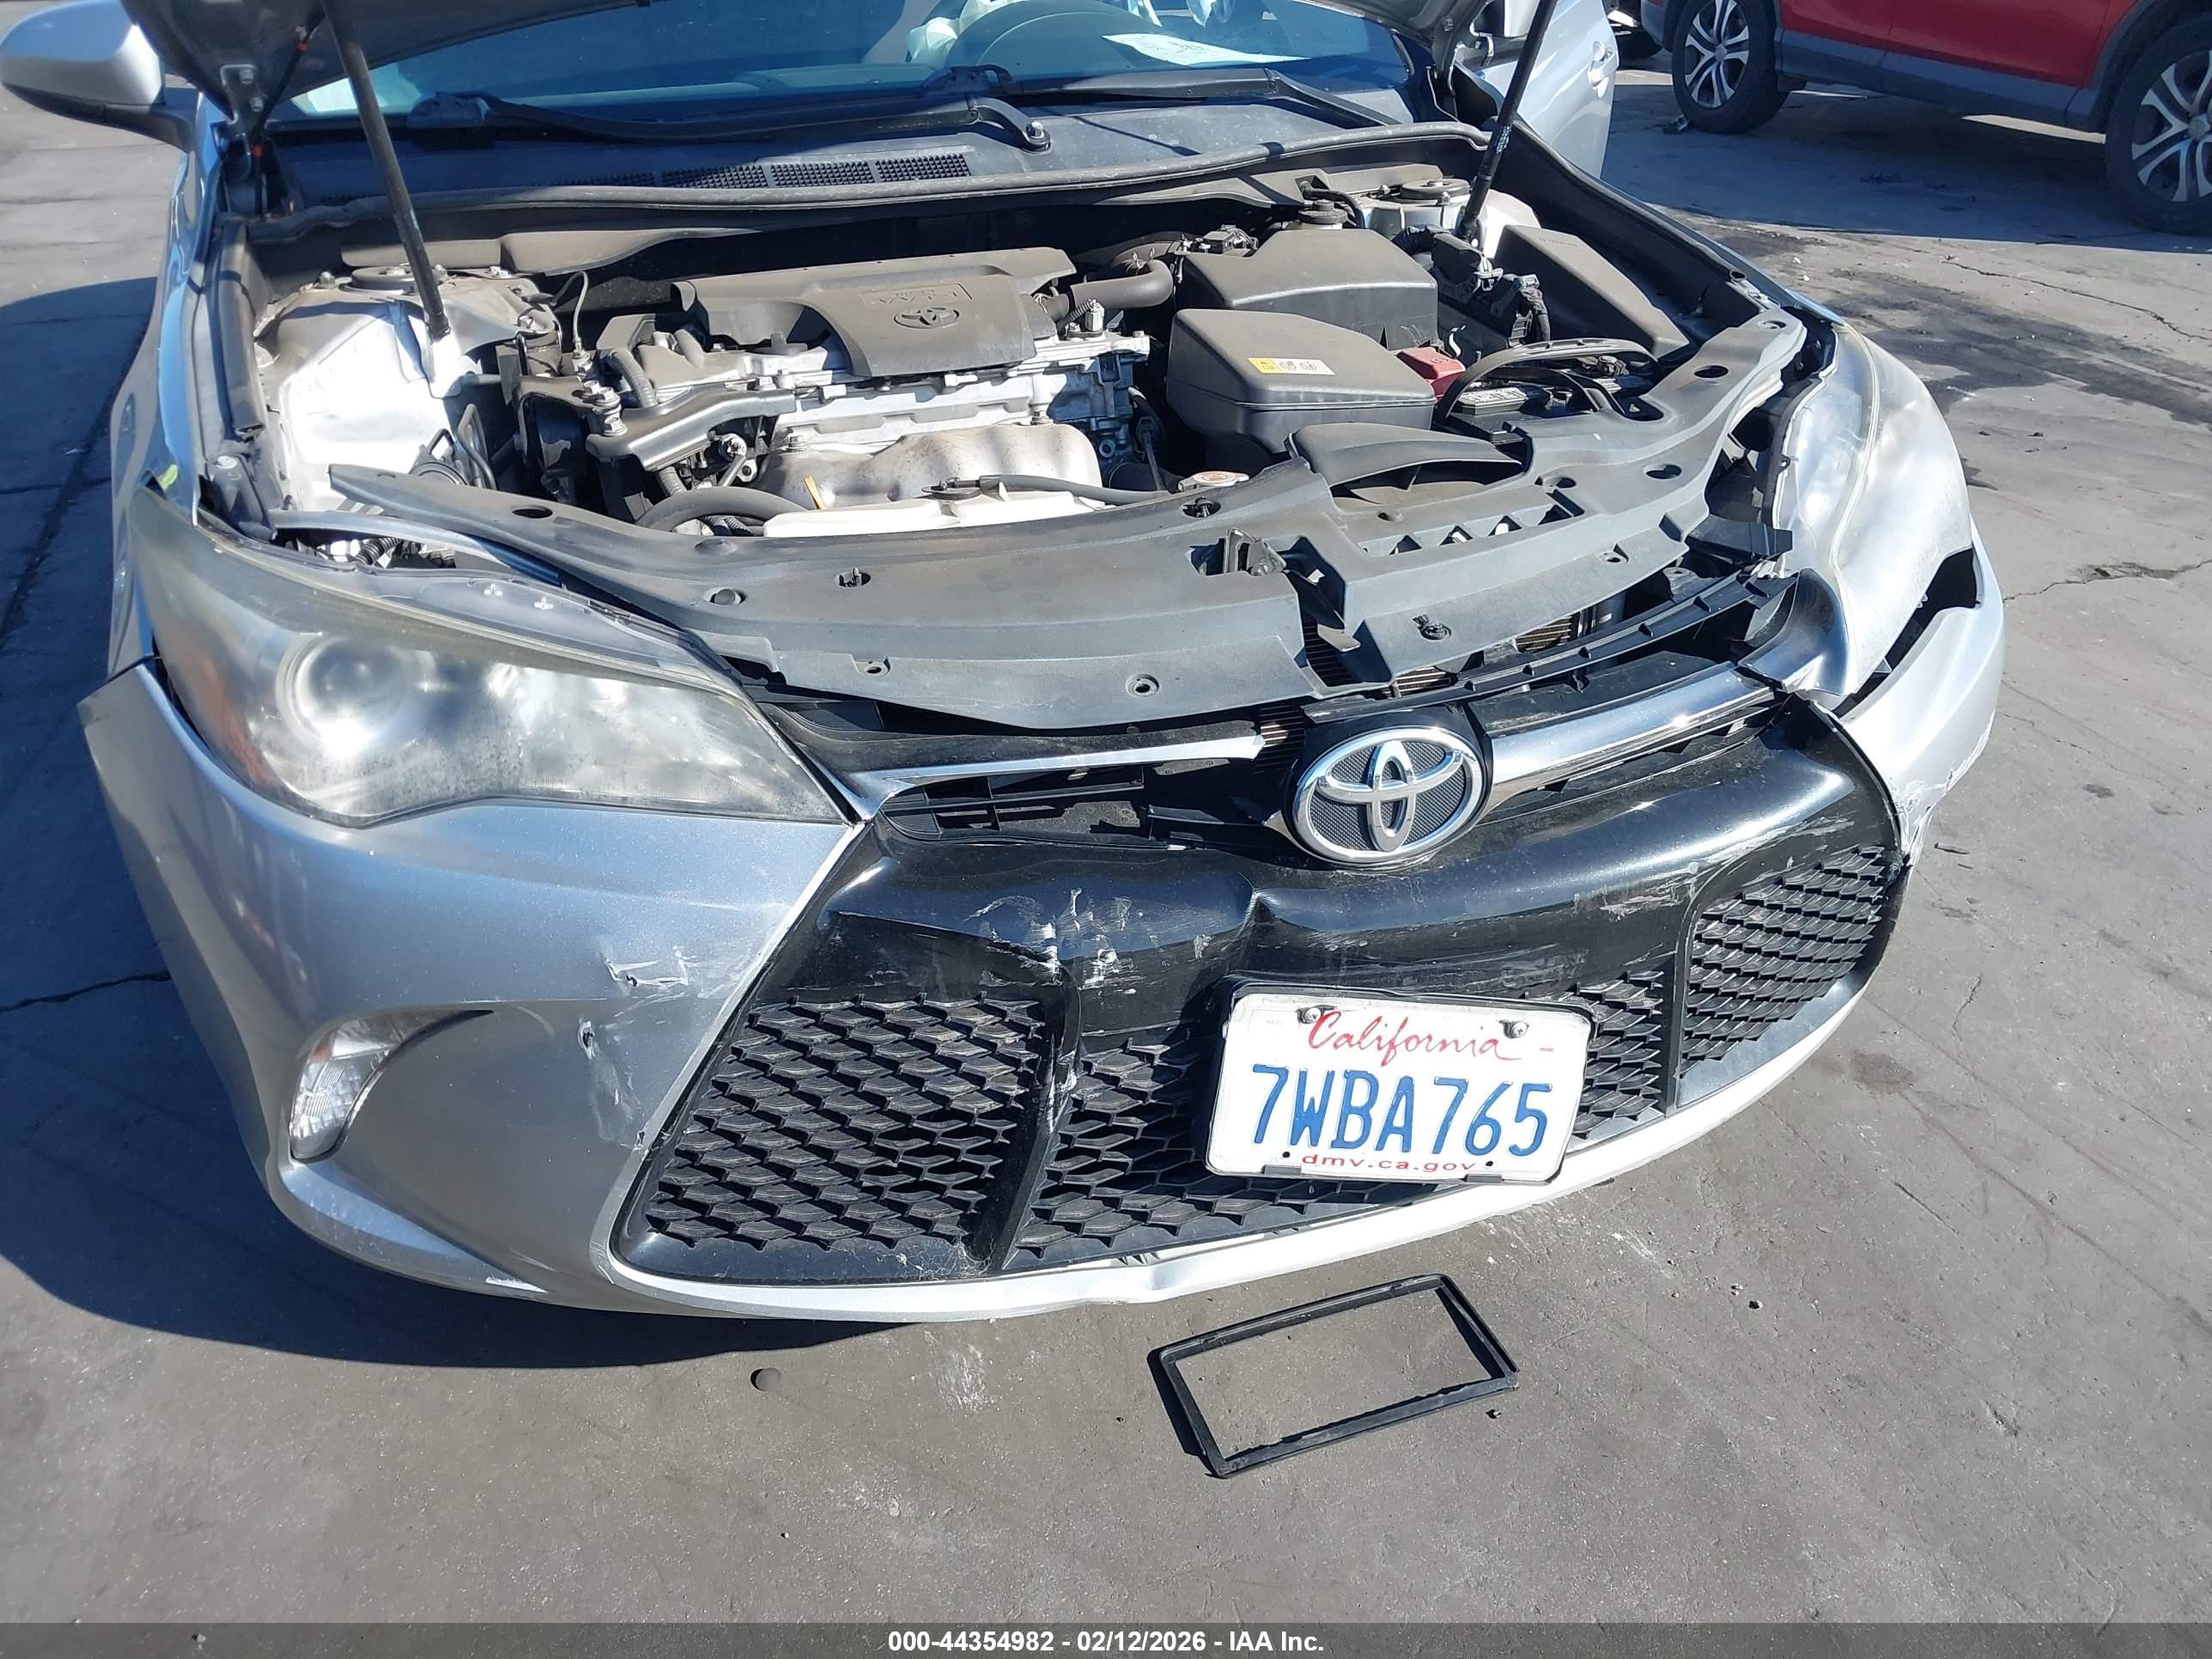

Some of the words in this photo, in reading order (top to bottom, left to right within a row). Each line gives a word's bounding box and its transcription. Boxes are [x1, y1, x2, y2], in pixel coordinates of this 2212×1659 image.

[1308, 1011, 1521, 1066] California
[1252, 1064, 1553, 1157] 7WBA765
[1301, 1154, 1477, 1173] dmv.ca.gov
